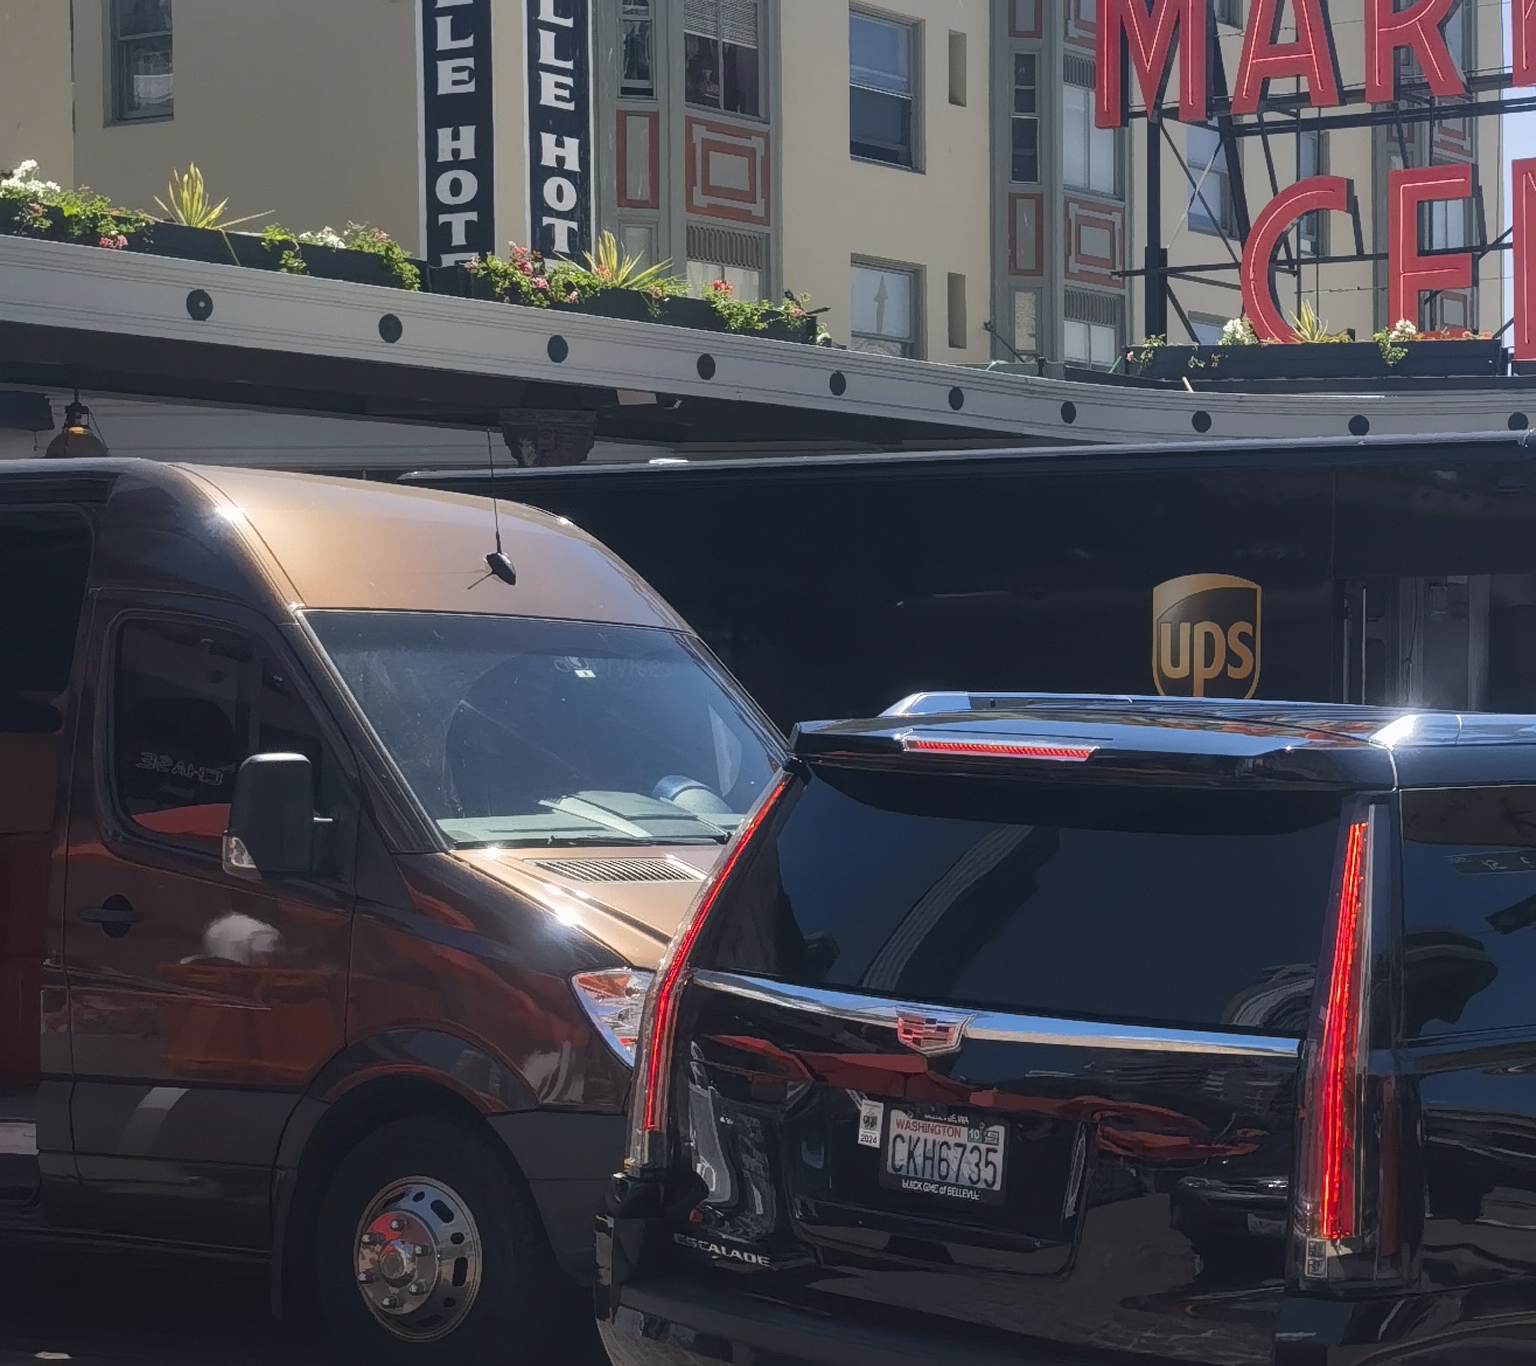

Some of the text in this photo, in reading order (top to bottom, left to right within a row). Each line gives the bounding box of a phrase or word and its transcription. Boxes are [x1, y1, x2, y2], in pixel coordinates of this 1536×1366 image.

[1160, 620, 1254, 698] ups
[859, 1134, 877, 1144] 2024
[896, 1119, 961, 1138] WASHINGTON
[969, 1128, 980, 1139] 10
[891, 1134, 998, 1188] CKH6735
[673, 1232, 771, 1267] ESCALADE
